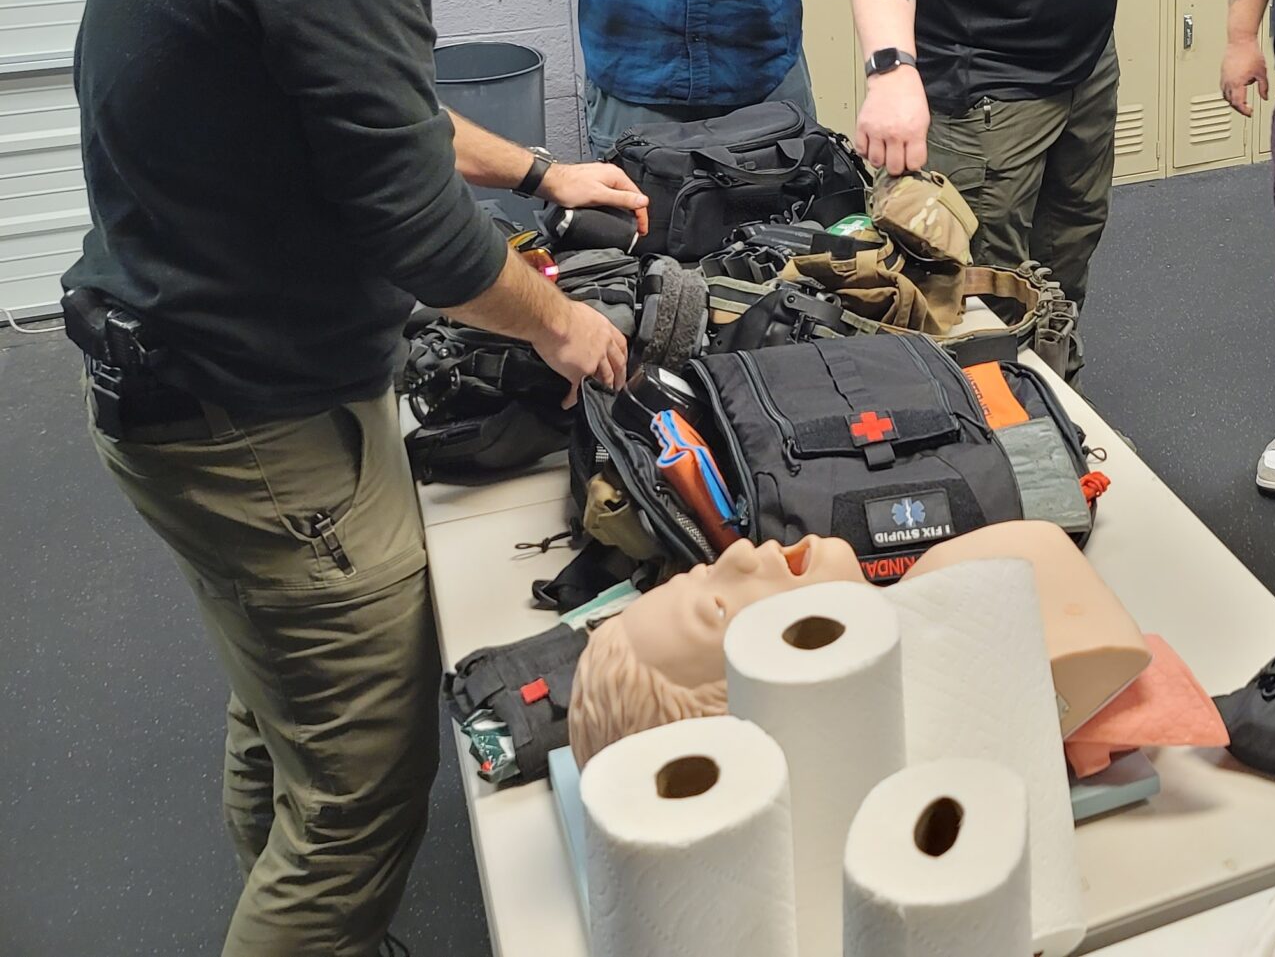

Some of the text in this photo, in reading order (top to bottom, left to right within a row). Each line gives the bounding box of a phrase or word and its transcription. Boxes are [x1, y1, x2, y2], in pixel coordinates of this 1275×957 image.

[874, 524, 952, 543] I FIX STUPID
